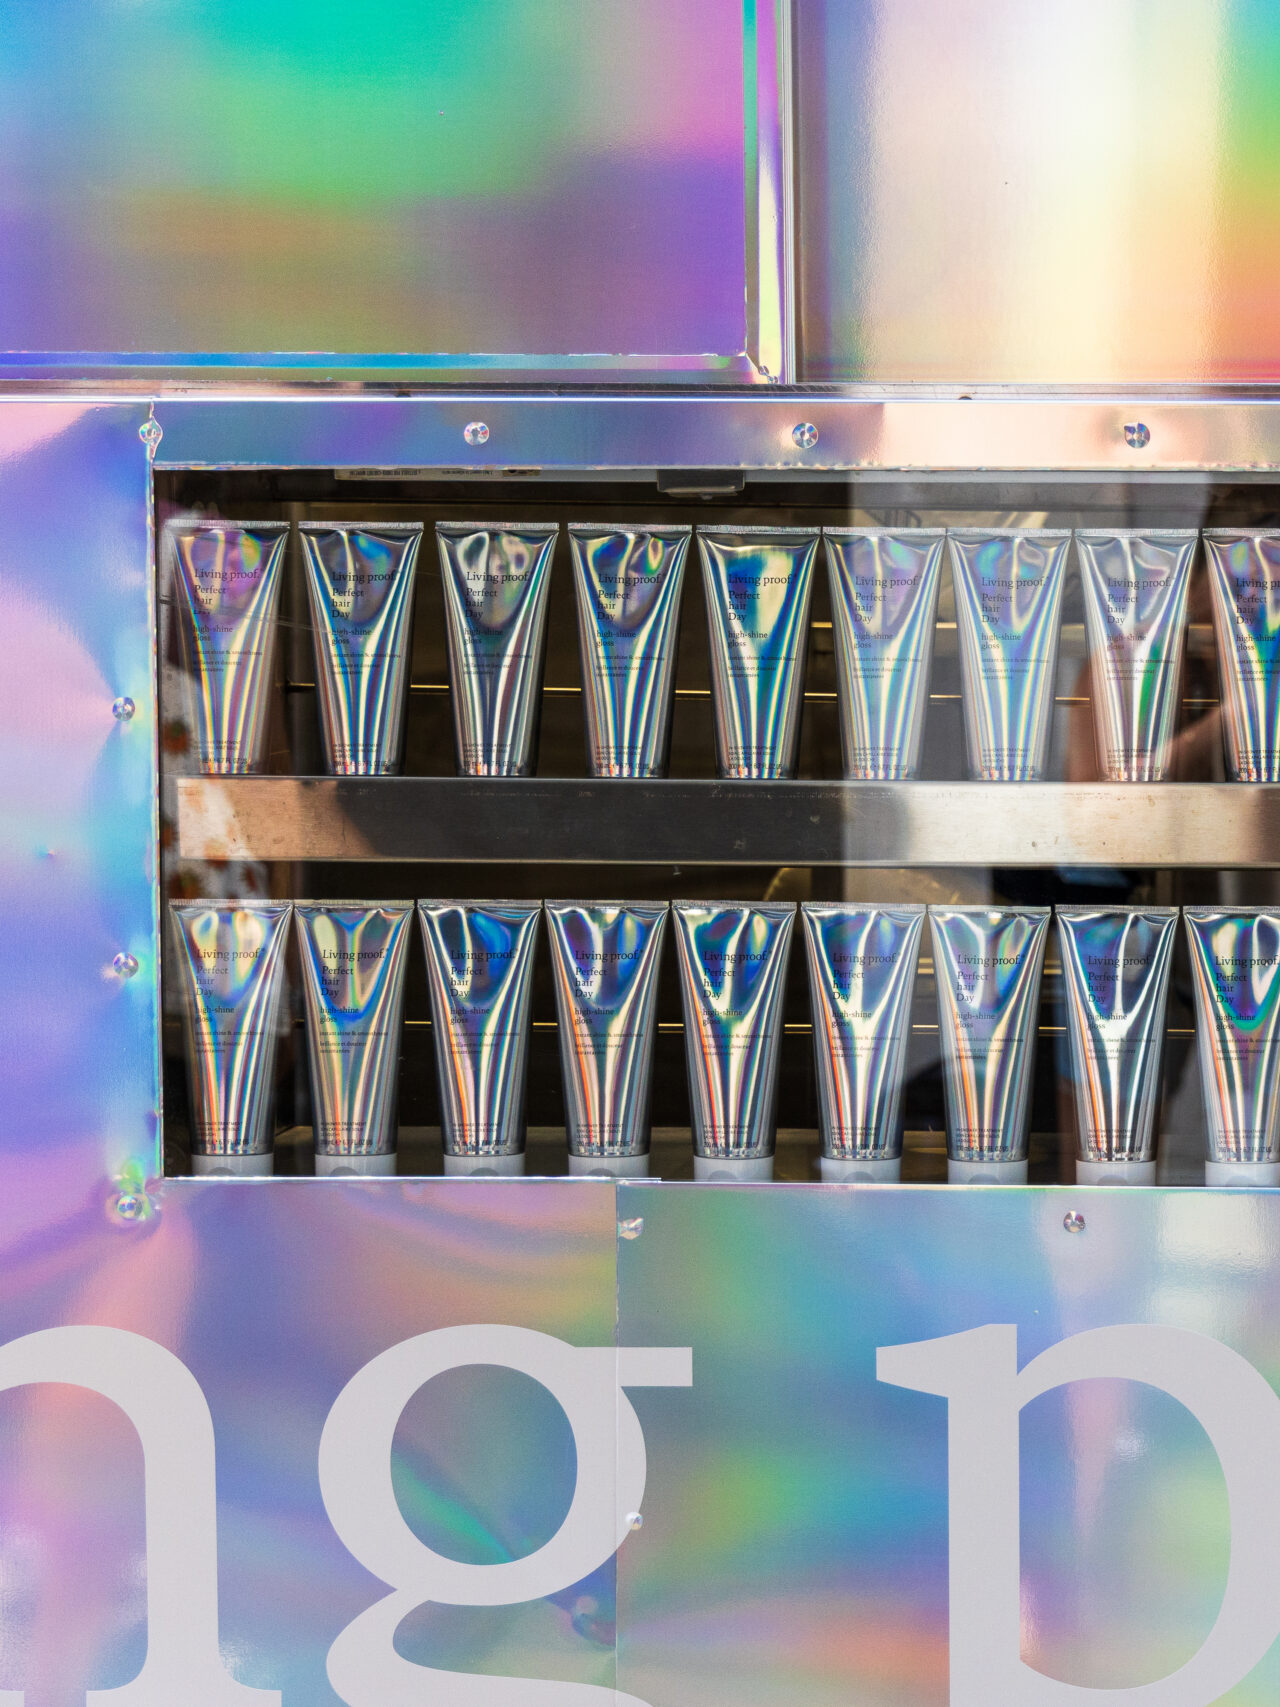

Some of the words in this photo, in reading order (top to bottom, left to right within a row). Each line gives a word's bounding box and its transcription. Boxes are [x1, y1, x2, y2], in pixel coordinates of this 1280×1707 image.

[332, 571, 365, 584] Living
[598, 573, 631, 586] Living
[728, 573, 761, 586] Living
[854, 575, 887, 588] Living
[981, 576, 1014, 589] Living
[1235, 577, 1268, 590] Living
[331, 587, 363, 596] Perfect
[597, 589, 629, 598] Perfect
[728, 590, 760, 599] Perfect
[854, 592, 886, 601] Perfect
[981, 592, 1013, 601] Perfect
[331, 598, 350, 607] hair
[1236, 593, 1268, 602] Perfect
[728, 600, 747, 609] hair
[331, 609, 350, 620] Day
[728, 612, 747, 623] Day
[322, 949, 355, 962] Living
[450, 949, 483, 962] Living
[575, 950, 608, 963] Living
[703, 950, 736, 963] Living
[833, 952, 866, 965] Living
[957, 954, 990, 967] Living
[1214, 955, 1247, 968] Living
[322, 965, 354, 974] Perfect
[450, 966, 482, 975] Perfect
[575, 966, 607, 975] Perfect
[703, 967, 735, 976] Perfect
[833, 969, 865, 978] Perfect
[957, 971, 989, 980] Perfect
[1215, 972, 1247, 981] Perfect
[575, 977, 594, 986] hair
[575, 988, 594, 999] Day
